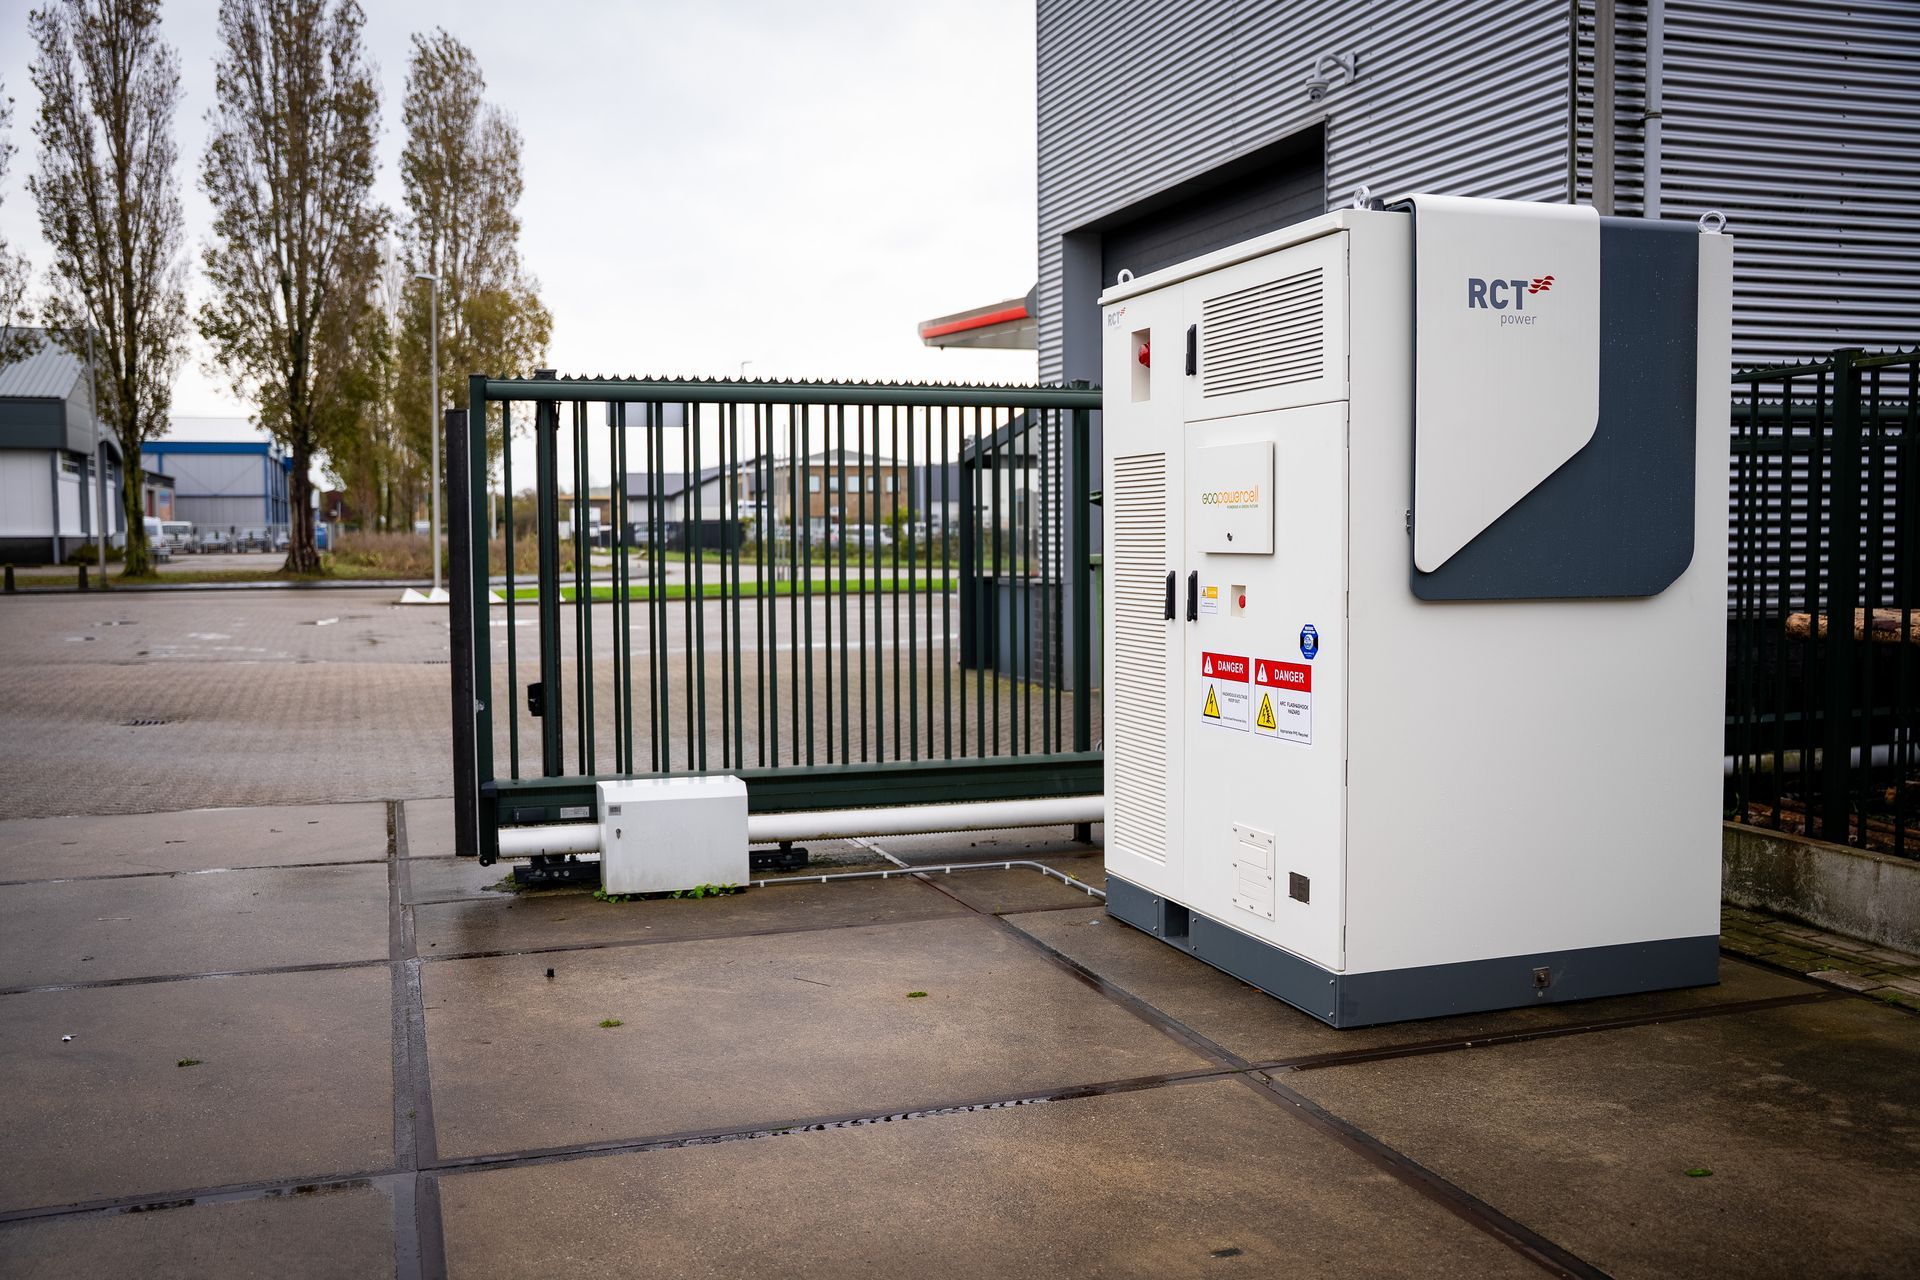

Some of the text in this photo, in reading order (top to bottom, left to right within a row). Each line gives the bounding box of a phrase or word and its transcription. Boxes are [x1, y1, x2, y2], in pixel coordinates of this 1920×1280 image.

[1469, 278, 1528, 310] RCT
[1107, 311, 1120, 326] RCT
[1500, 314, 1537, 327] power
[1218, 661, 1244, 674] DANGER
[1275, 669, 1304, 683] DANGER
